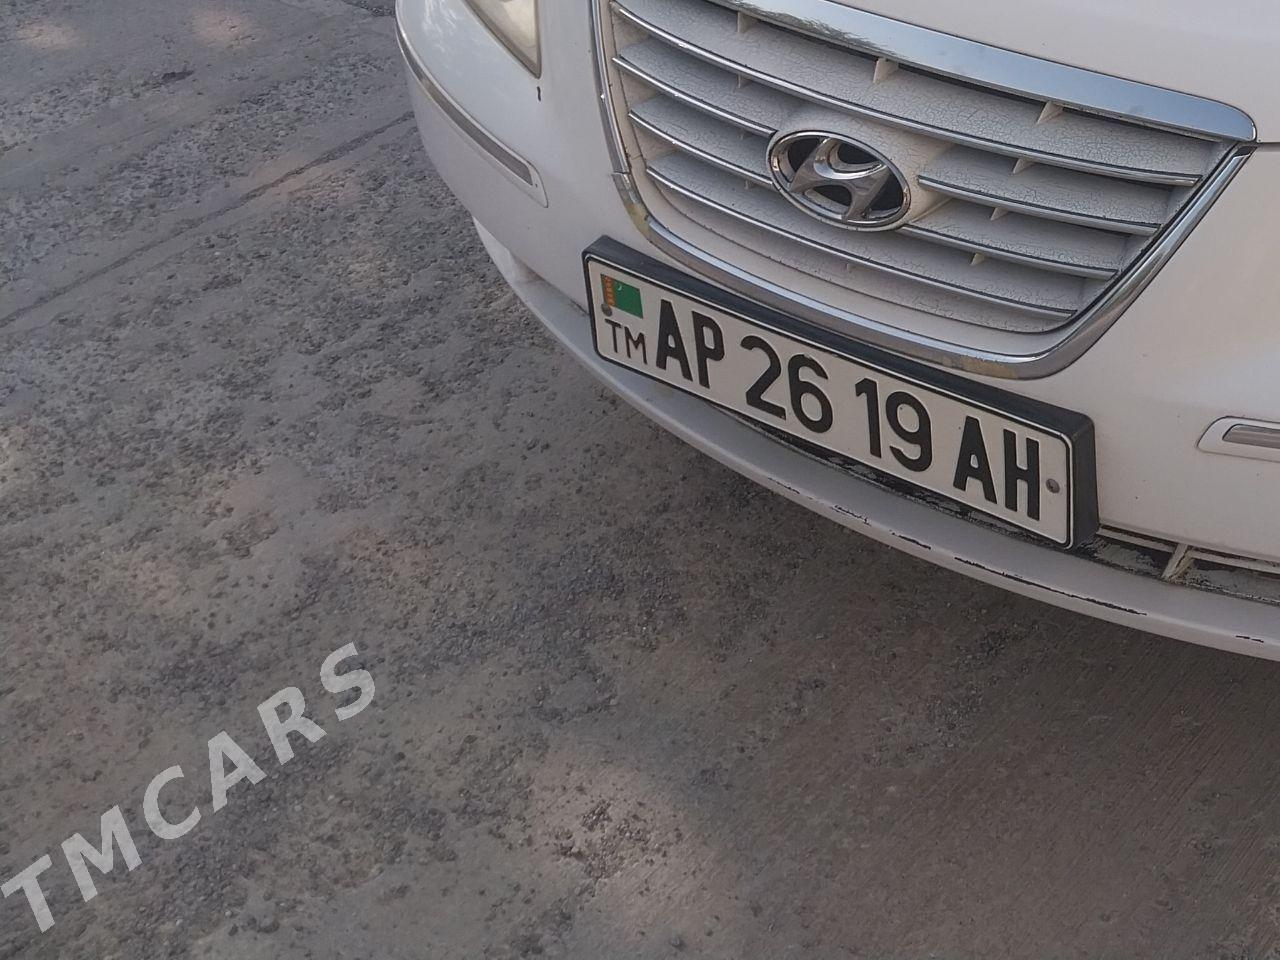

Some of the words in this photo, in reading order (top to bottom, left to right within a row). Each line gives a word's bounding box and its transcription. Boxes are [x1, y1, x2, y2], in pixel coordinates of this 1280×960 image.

[604, 317, 648, 365] TM
[655, 299, 725, 389] AP
[739, 335, 834, 434] 26
[854, 377, 934, 473] 19
[952, 415, 1041, 521] AH
